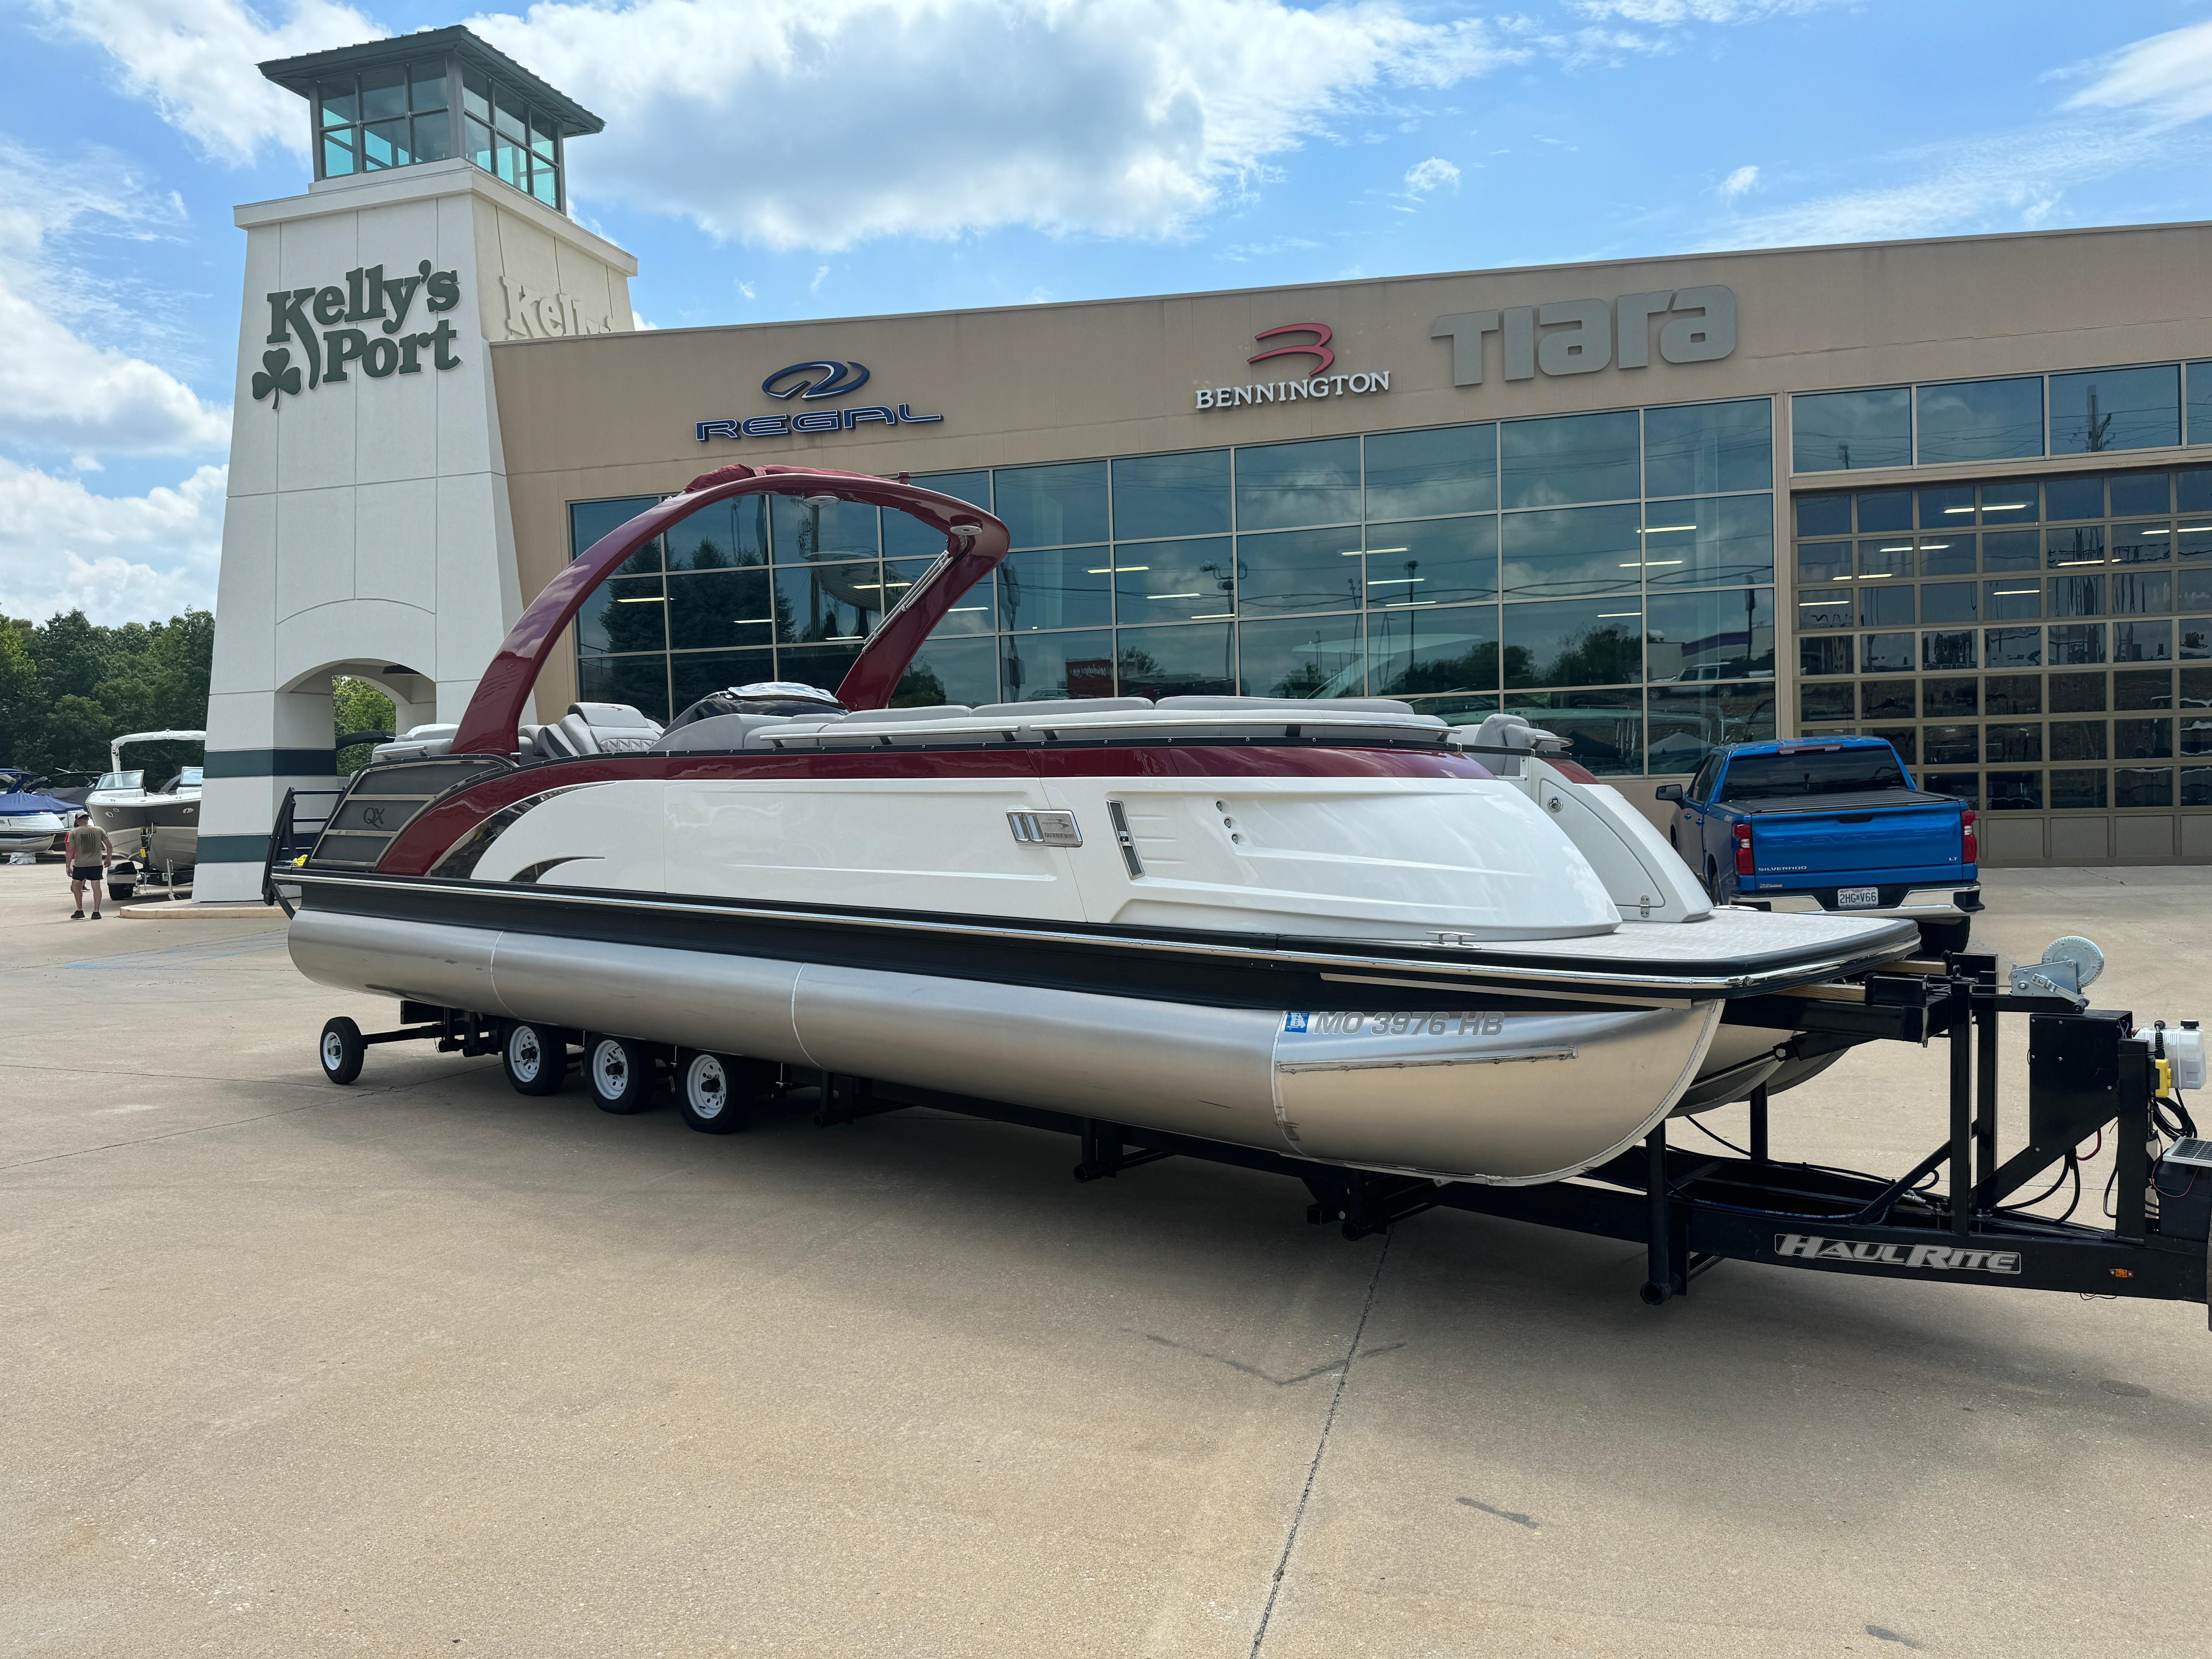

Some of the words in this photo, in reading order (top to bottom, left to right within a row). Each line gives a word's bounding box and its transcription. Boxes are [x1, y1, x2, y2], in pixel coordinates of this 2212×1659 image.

[266, 259, 460, 390] Kelly's
[323, 319, 462, 383] Port
[1195, 371, 1390, 409] BENNINGTON
[696, 403, 944, 442] REGAL
[363, 807, 385, 828] QX
[1840, 893, 1856, 903] 2HG
[1860, 892, 1876, 902] V66
[1313, 1011, 1365, 1035] MO
[1371, 1012, 1449, 1036] 3976
[1458, 1011, 1505, 1037] HB
